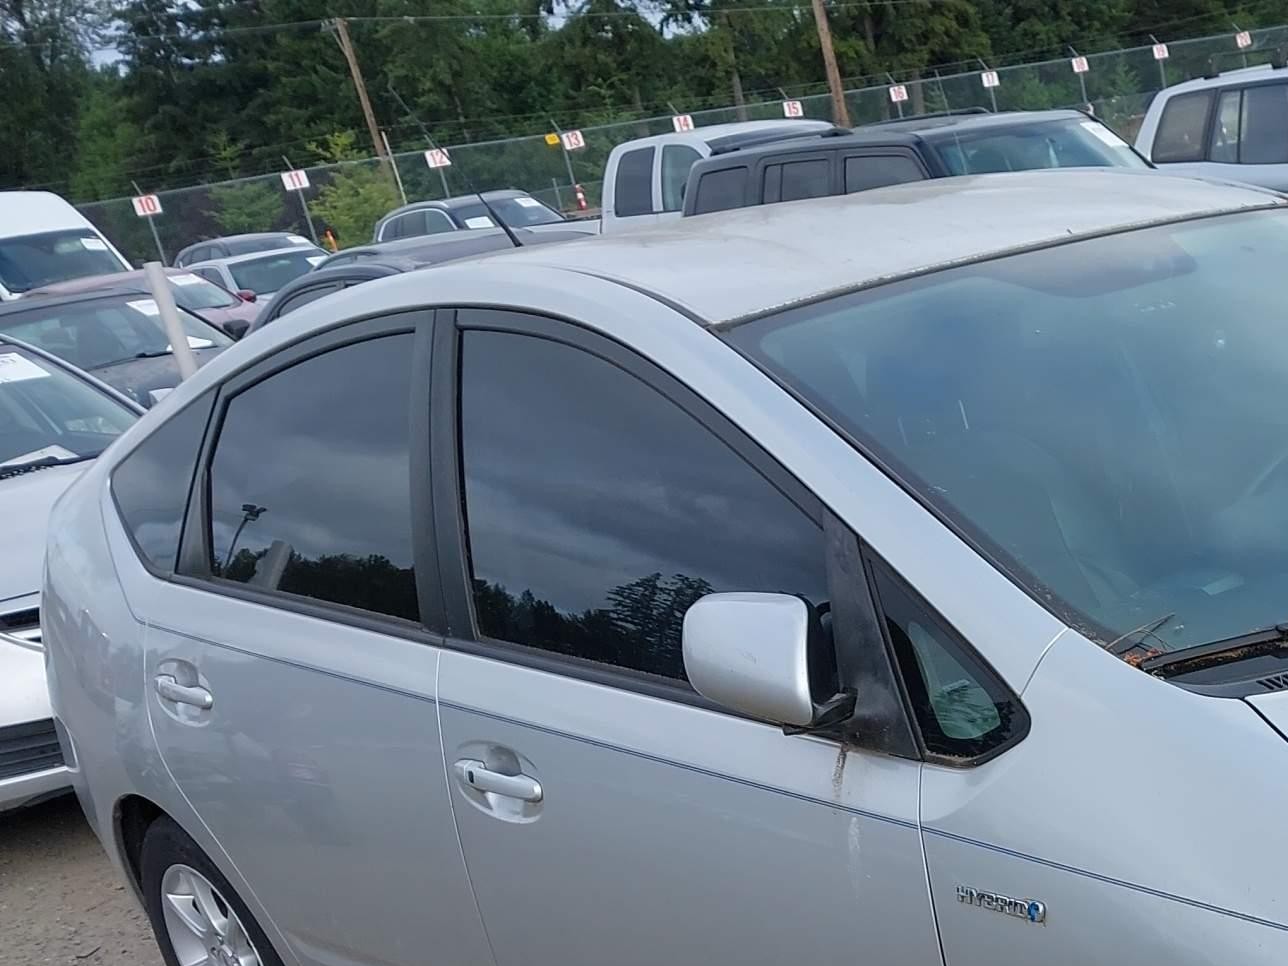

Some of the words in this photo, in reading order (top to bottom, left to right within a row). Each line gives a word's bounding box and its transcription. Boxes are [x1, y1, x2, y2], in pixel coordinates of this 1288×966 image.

[565, 131, 581, 148] 13
[288, 172, 304, 188] 11
[138, 196, 158, 213] 10
[956, 886, 1028, 919] HYBRID
